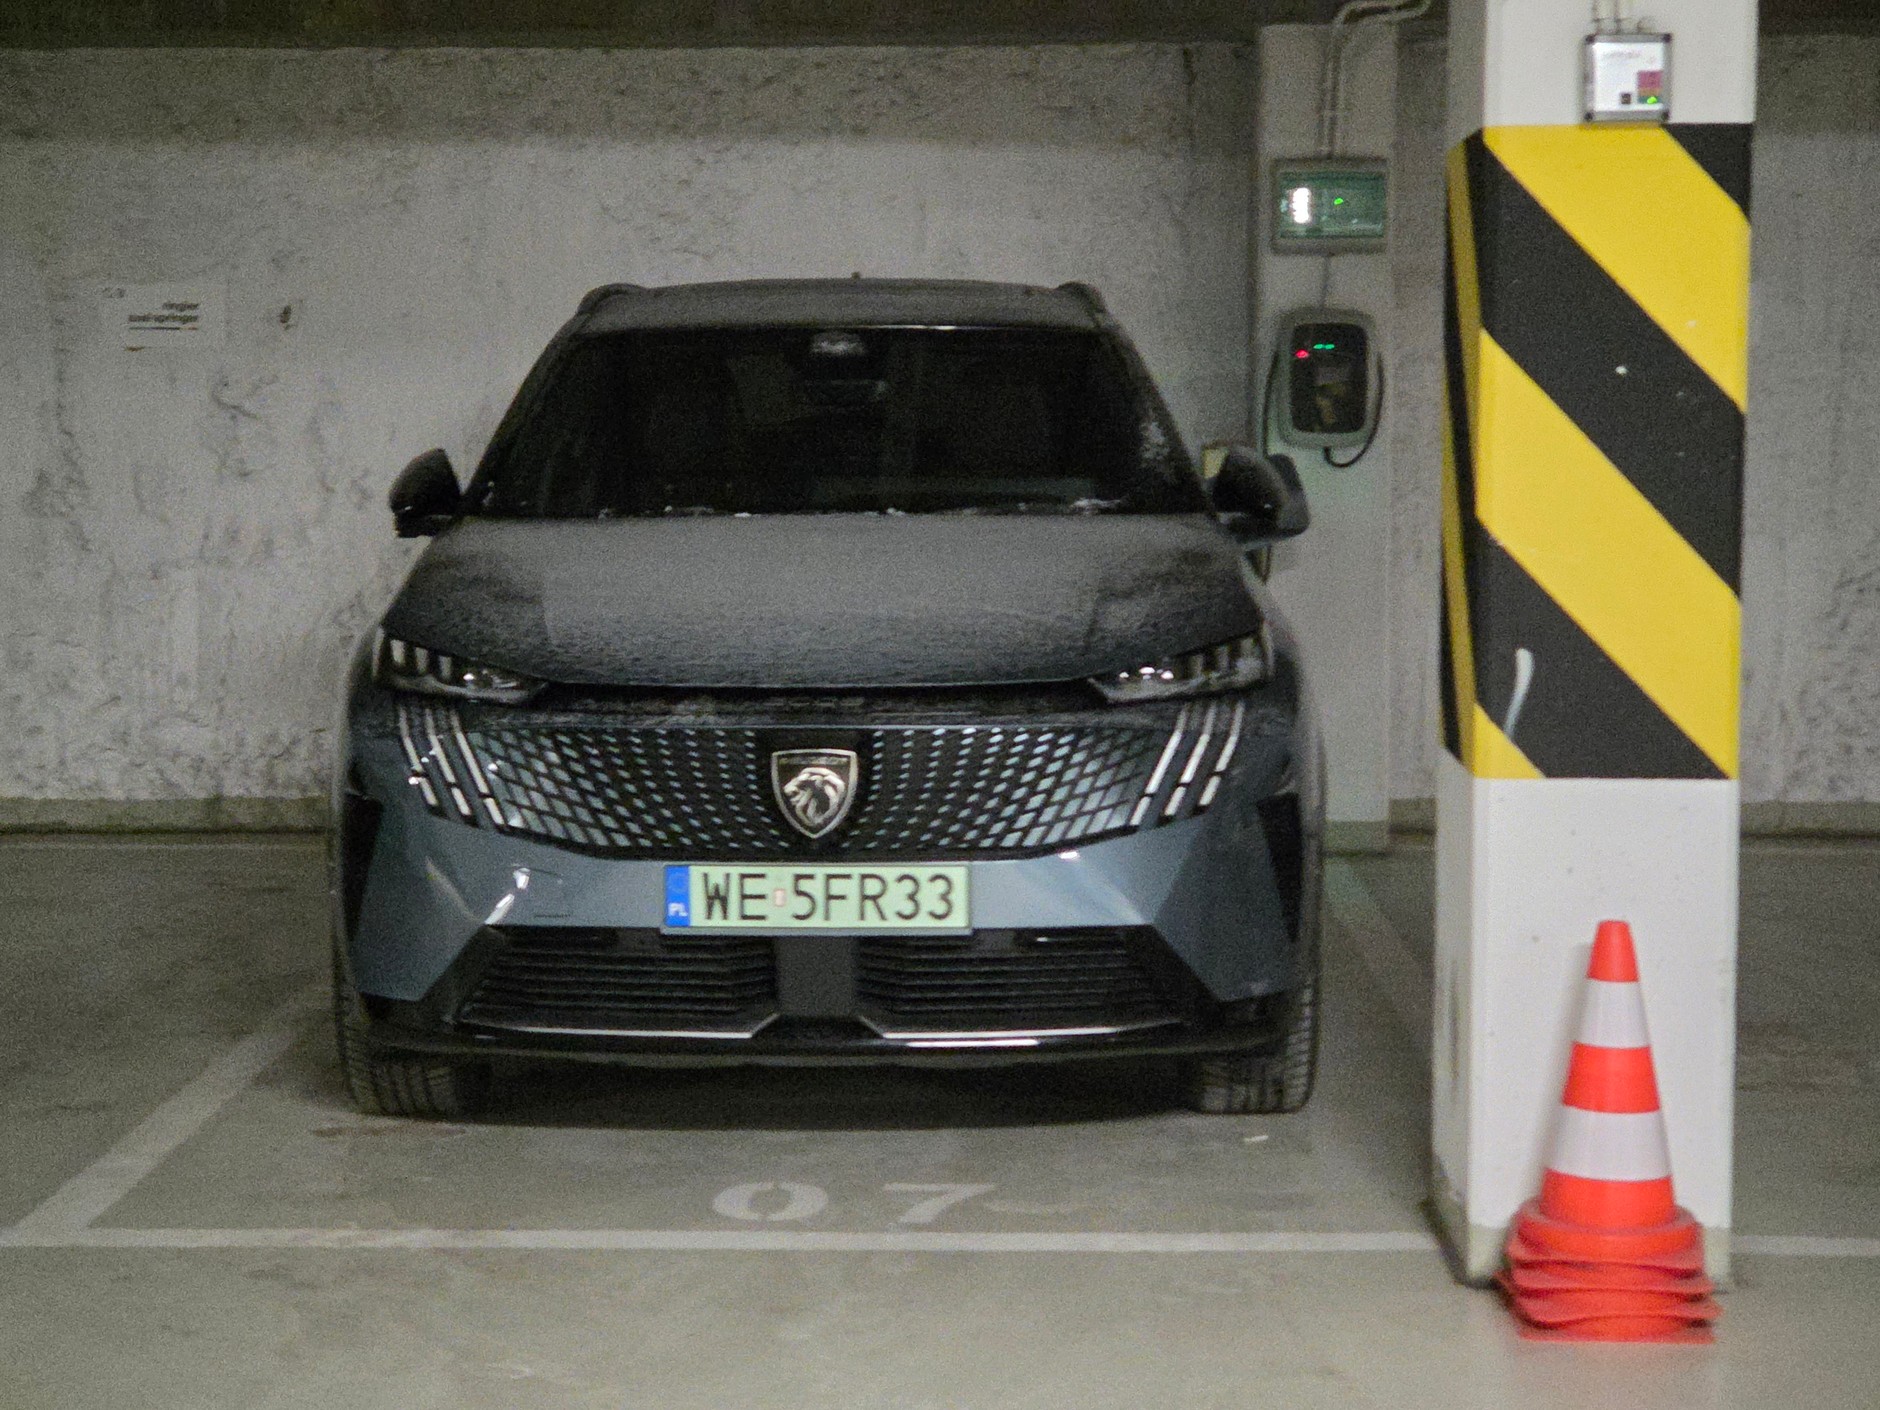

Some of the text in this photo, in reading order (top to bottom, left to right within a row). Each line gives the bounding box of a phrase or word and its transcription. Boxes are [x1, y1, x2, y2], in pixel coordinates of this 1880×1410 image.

[668, 903, 688, 917] PL
[702, 872, 954, 921] WE 5FR33
